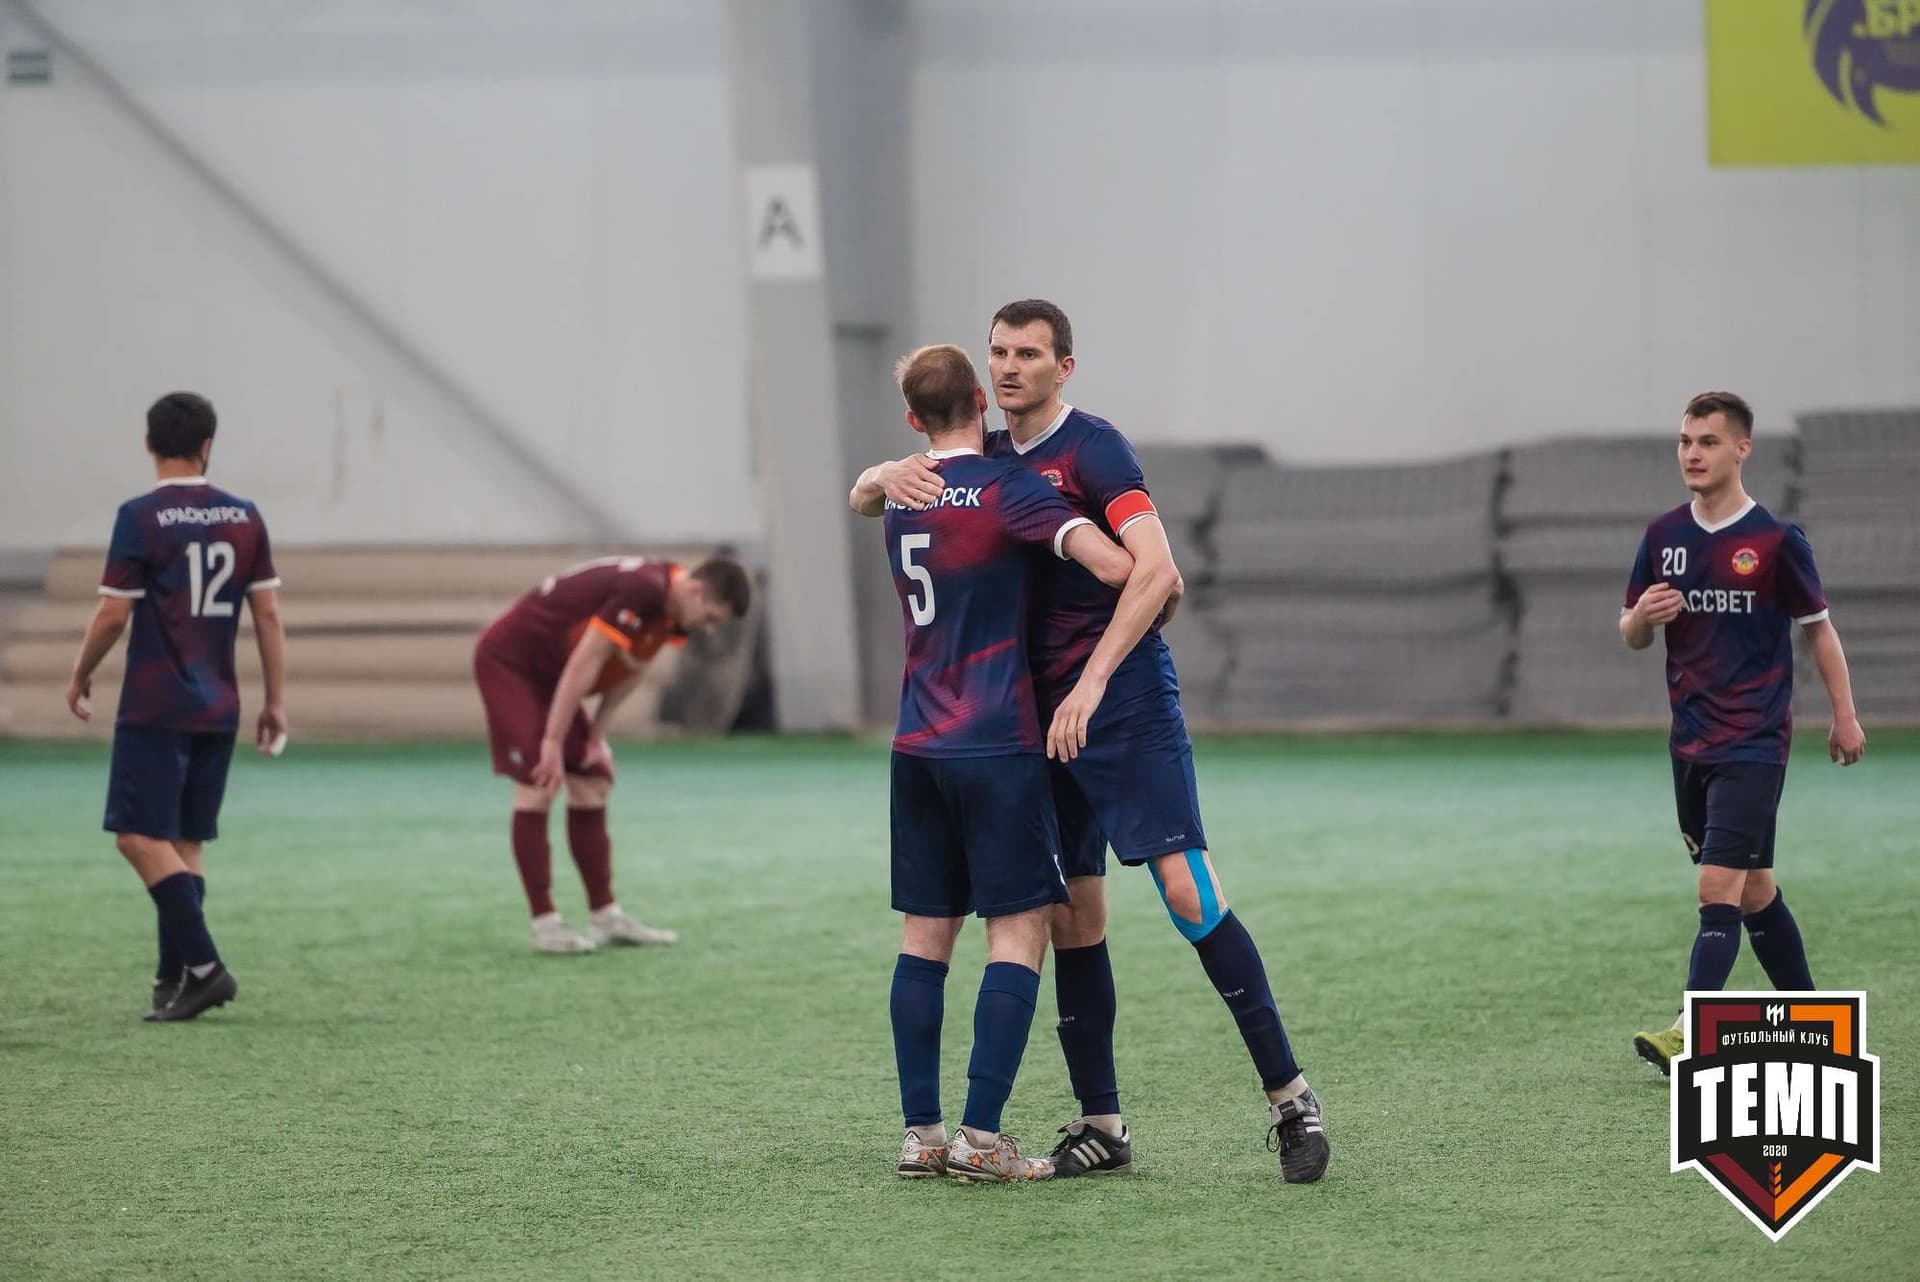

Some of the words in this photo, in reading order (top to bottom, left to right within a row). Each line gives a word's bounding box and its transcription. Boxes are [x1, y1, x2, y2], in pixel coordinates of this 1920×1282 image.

[185, 541, 236, 617] 12
[901, 533, 936, 626] 5
[1661, 547, 1687, 576] 20
[1679, 589, 1756, 614] АССВЕТ
